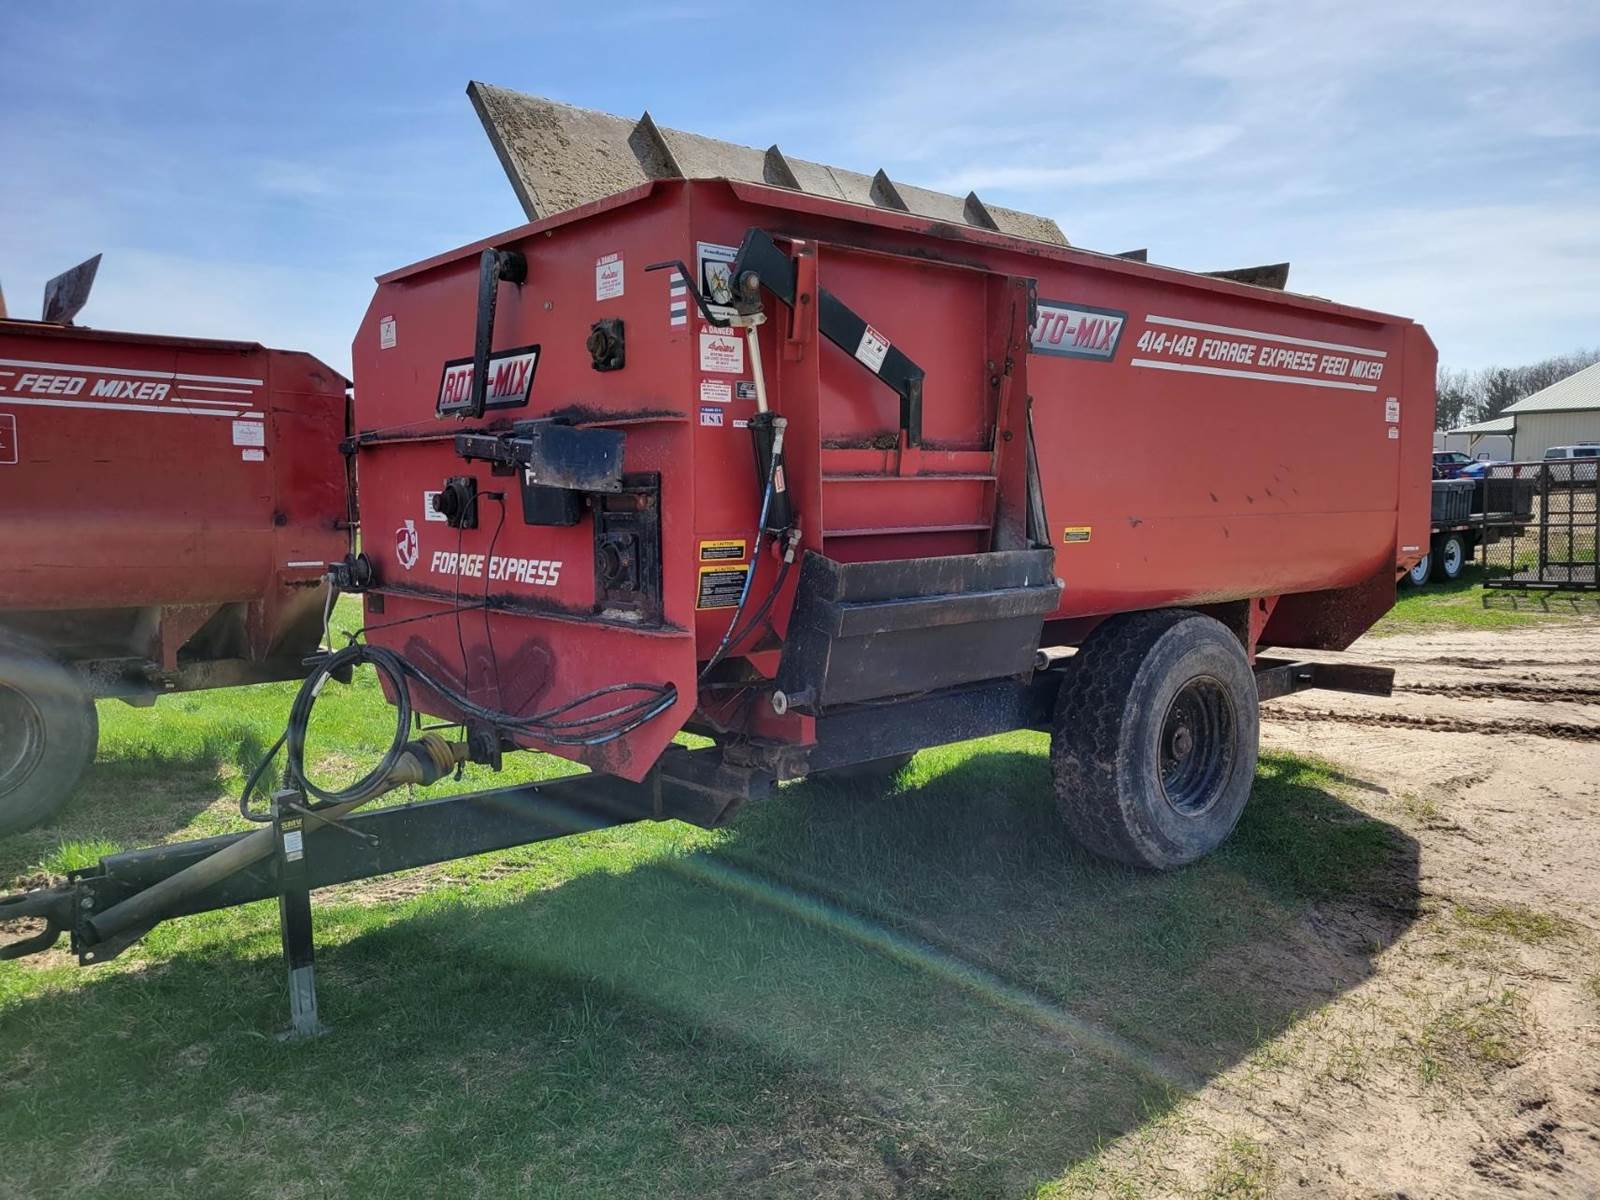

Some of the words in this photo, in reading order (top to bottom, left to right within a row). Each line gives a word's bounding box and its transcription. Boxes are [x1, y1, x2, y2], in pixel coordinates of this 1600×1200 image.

[1034, 309, 1119, 351] TO-MIX
[1199, 339, 1256, 364] FORAGE
[1258, 347, 1318, 372] EXPRESS
[1319, 355, 1349, 376] FEED
[1350, 359, 1384, 380] MIXER
[14, 373, 87, 396] FEED
[90, 379, 171, 401] MIXER
[441, 358, 532, 404] ROT-MIX
[430, 551, 485, 578] FORAGE
[488, 556, 562, 586] EXPRESS
